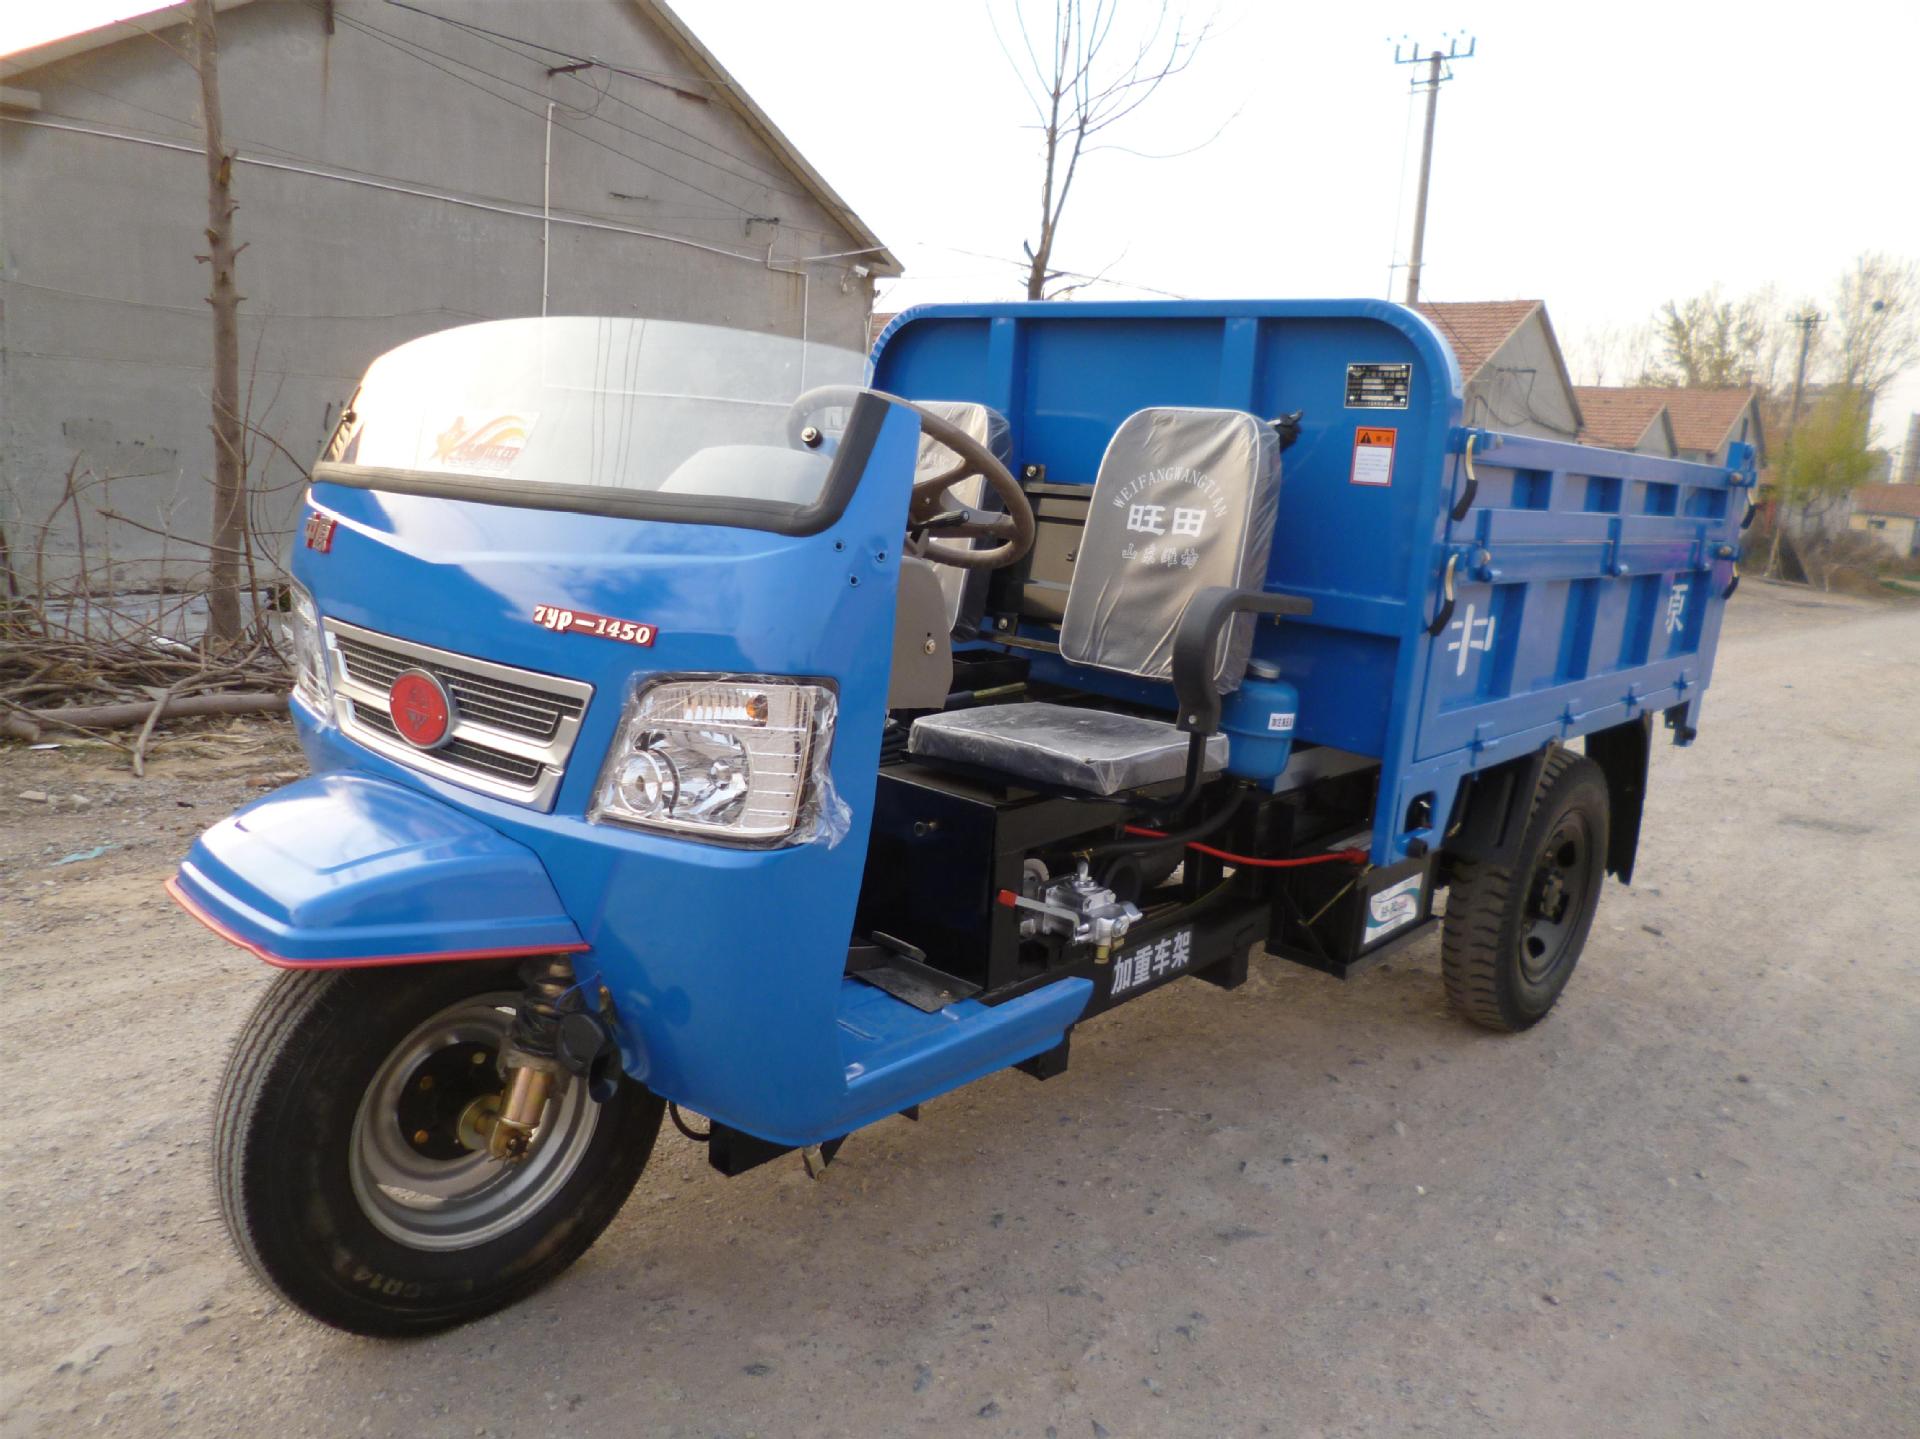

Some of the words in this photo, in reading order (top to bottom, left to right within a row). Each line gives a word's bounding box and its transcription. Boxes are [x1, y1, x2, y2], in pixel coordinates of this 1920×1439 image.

[1126, 504, 1207, 537] 旺田
[1111, 931, 1191, 995] 加重车架
